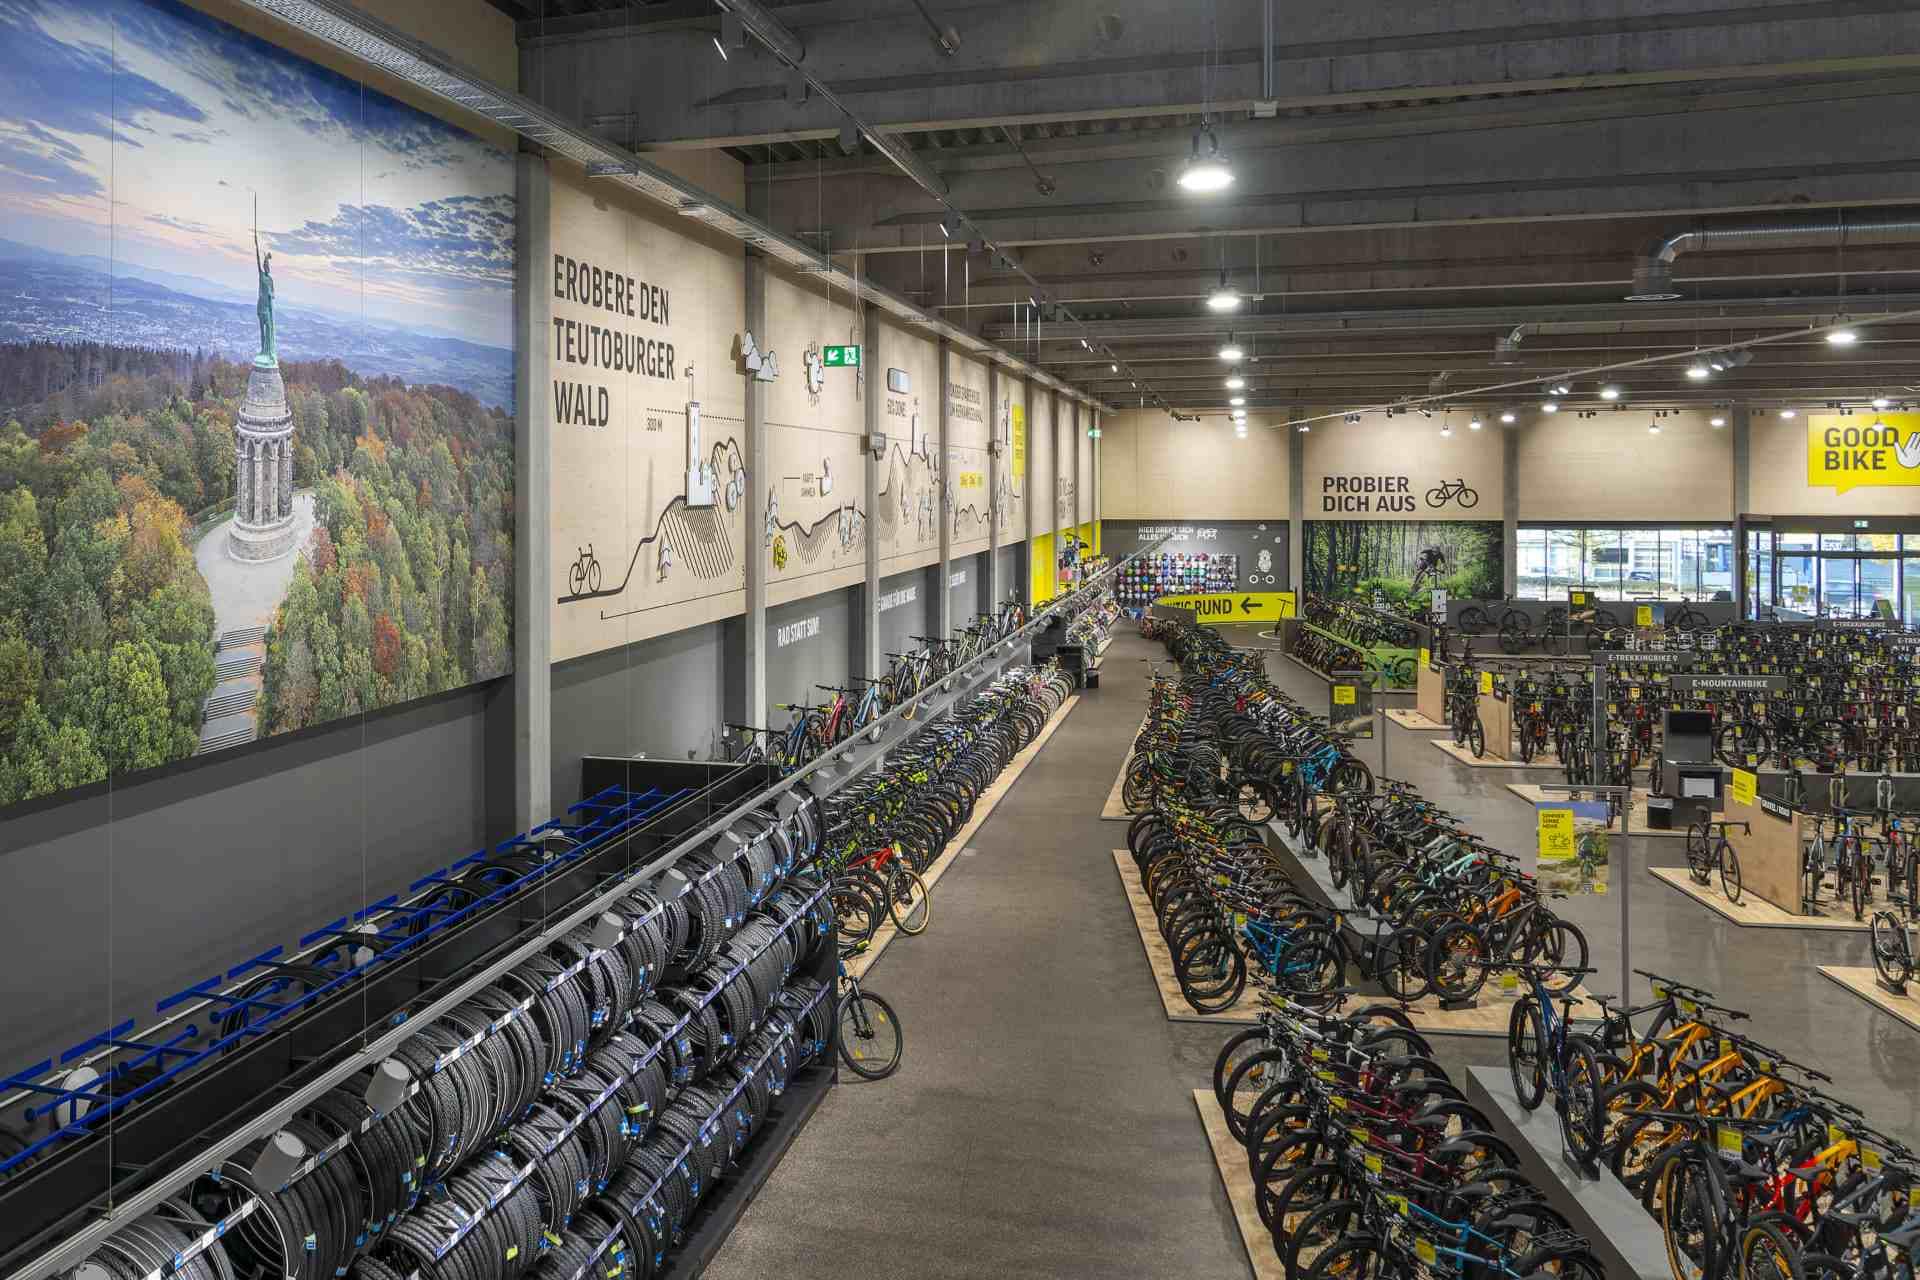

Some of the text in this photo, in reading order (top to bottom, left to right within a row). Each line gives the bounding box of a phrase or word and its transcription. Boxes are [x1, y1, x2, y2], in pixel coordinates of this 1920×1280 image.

[554, 253, 669, 327] EROBERE DEN
[553, 317, 675, 381] TEUTOBURGER
[554, 380, 609, 428] WALD
[1824, 427, 1899, 447] GOOD
[1824, 450, 1887, 470] BIKE
[1322, 476, 1409, 493] PROBIER
[1322, 496, 1416, 512] DICH AUS
[1195, 599, 1232, 615] RUND
[1692, 679, 1768, 688] E-MOUNTAINBIKE
